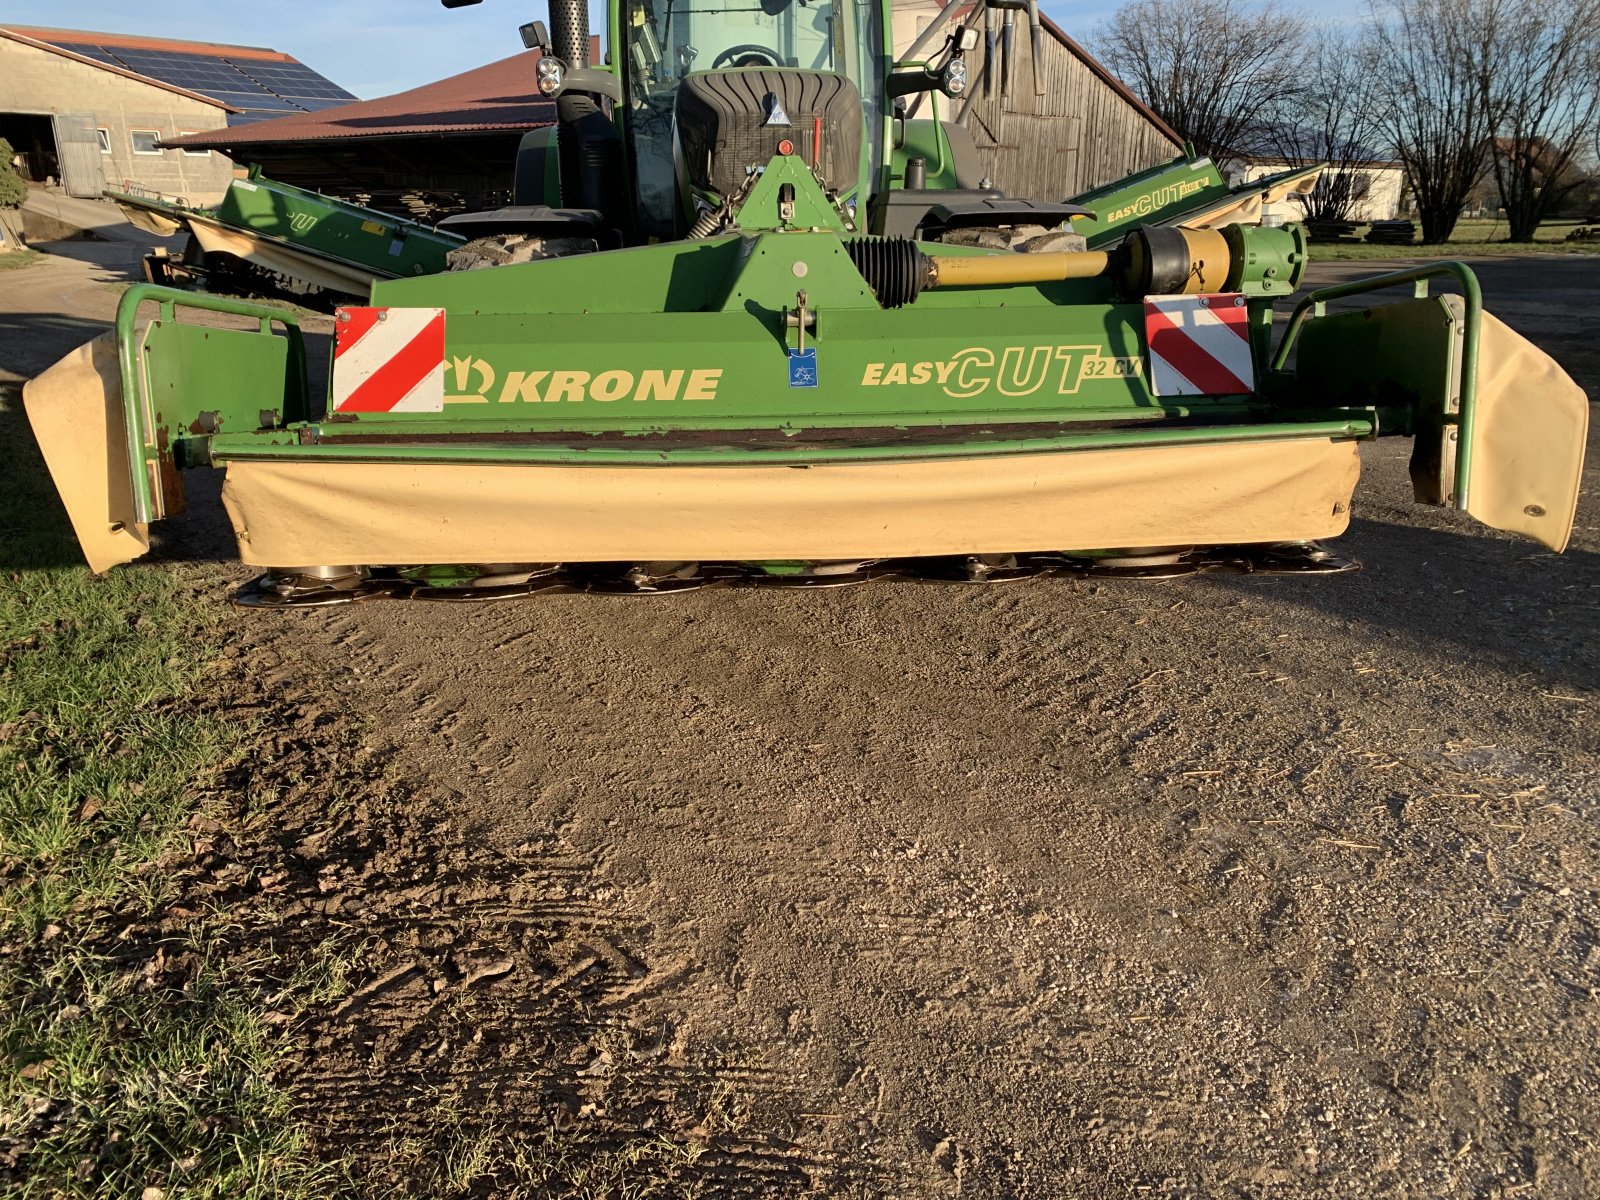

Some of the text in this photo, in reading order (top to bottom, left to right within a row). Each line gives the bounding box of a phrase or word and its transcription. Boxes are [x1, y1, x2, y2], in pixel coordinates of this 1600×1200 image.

[1084, 360, 1107, 376] 32
[1112, 359, 1140, 375] CV
[498, 369, 723, 403] KRONE
